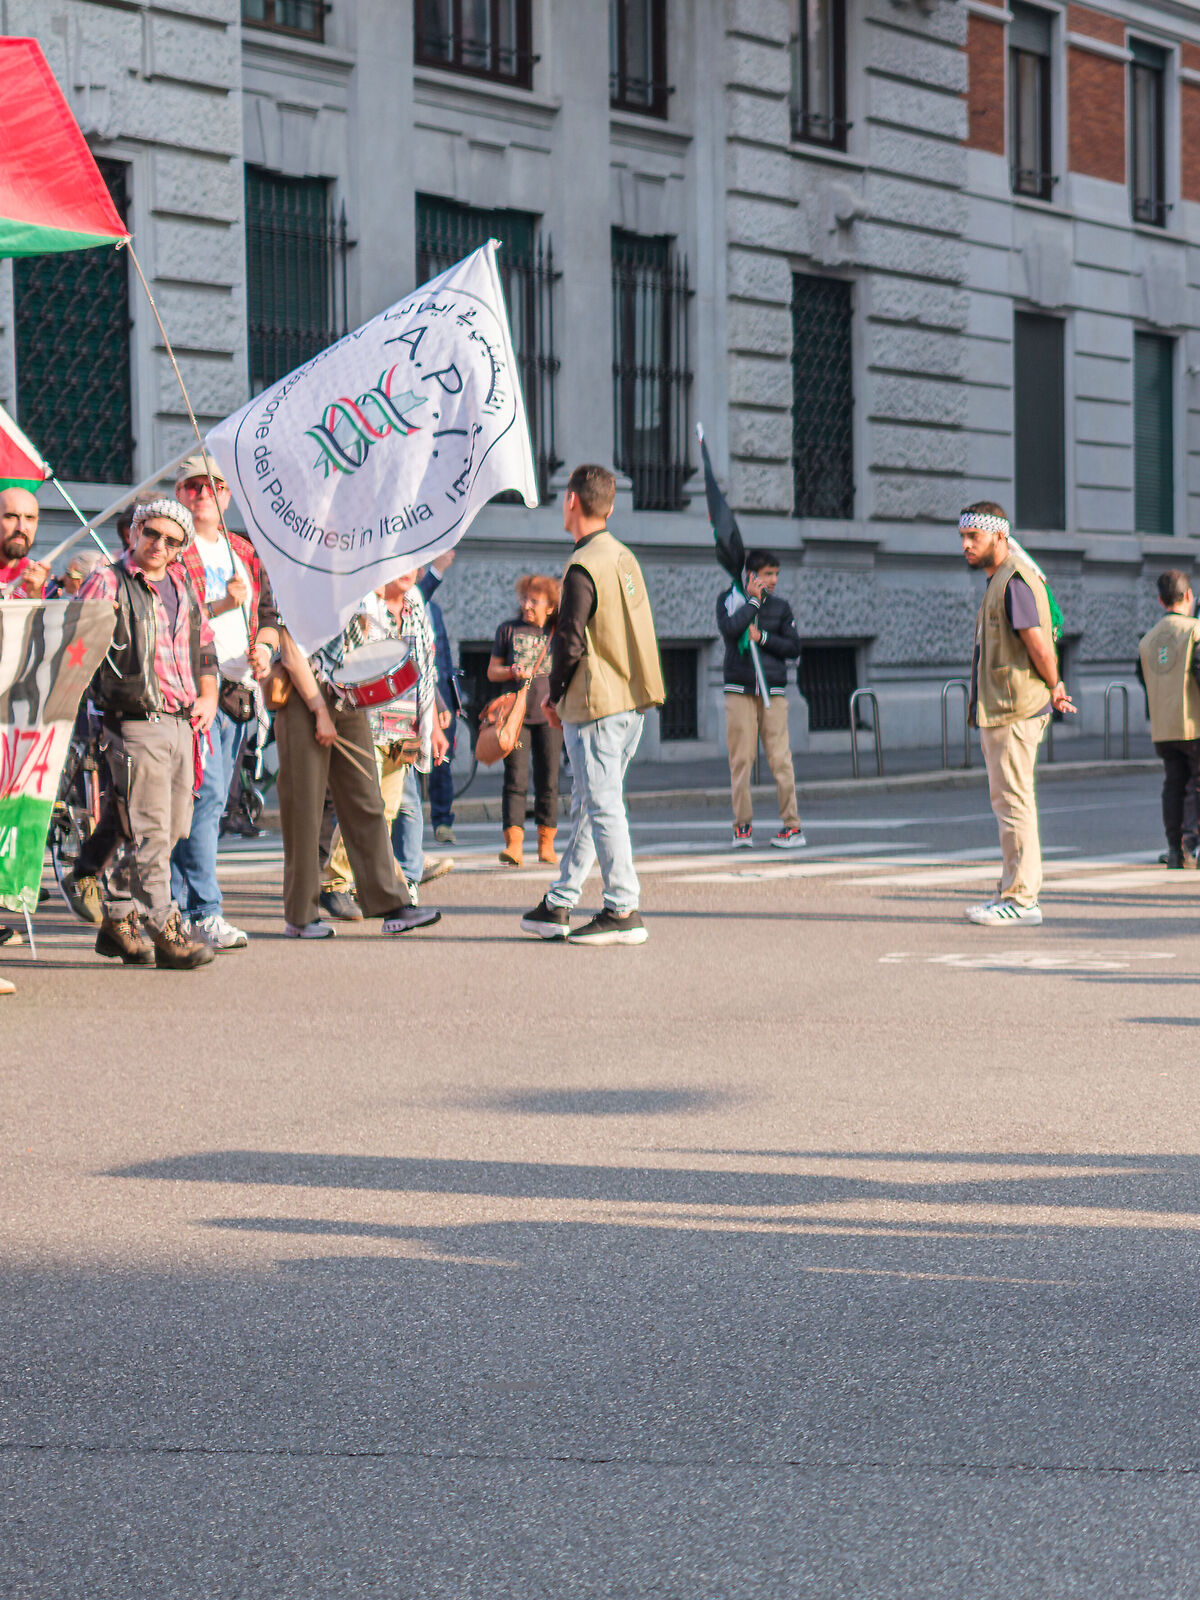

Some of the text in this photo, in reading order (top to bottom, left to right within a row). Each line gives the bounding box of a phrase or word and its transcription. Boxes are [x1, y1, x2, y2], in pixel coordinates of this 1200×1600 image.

[455, 306, 477, 326] في
[253, 445, 276, 481] dei
[262, 478, 356, 550] Palestinesi
[379, 503, 435, 539] Italia
[359, 527, 374, 549] in
